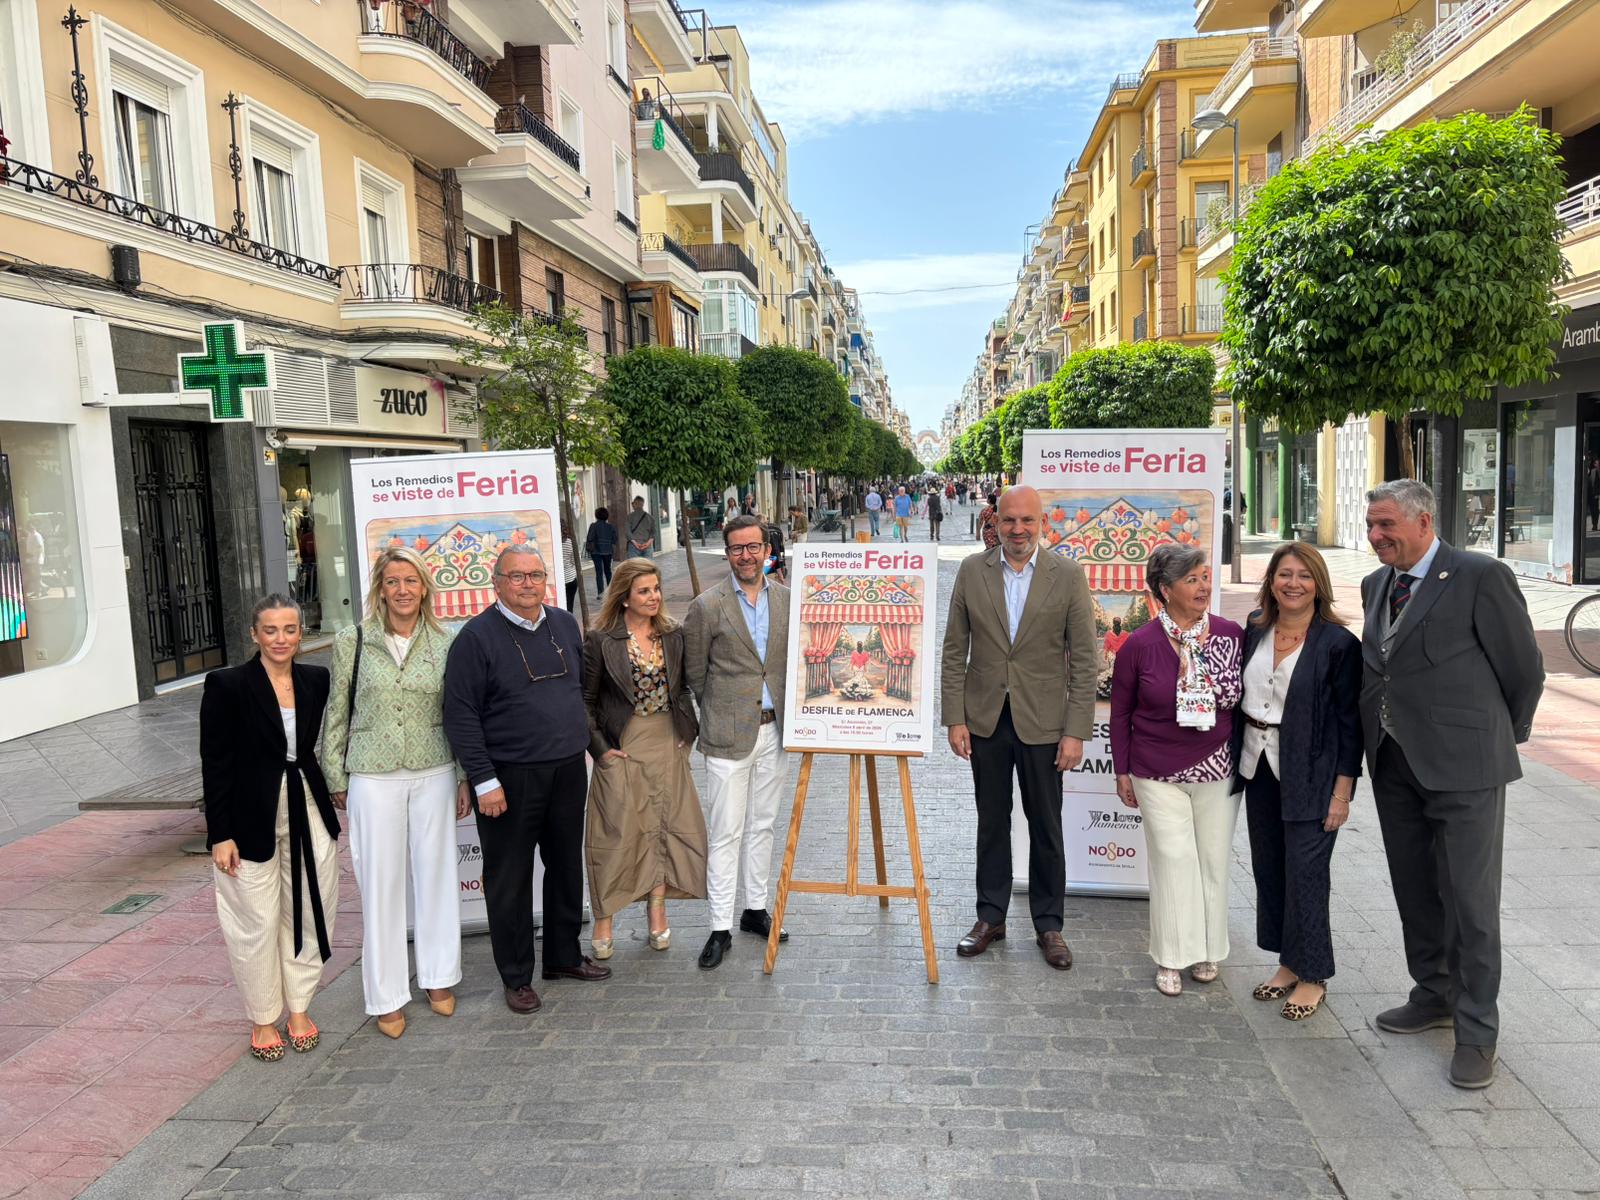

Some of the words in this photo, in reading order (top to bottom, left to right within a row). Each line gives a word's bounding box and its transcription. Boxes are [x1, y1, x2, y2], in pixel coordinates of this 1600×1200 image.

[1562, 321, 1600, 349] Aramb
[1040, 449, 1061, 459] Los
[1064, 448, 1121, 459] Remedios
[1040, 462, 1056, 473] se
[1059, 459, 1100, 473] viste
[1103, 462, 1120, 473] de
[1124, 447, 1206, 474] Feria
[371, 478, 393, 488] Los
[395, 474, 454, 486] Remedios
[372, 493, 389, 503] se
[392, 486, 433, 502] viste
[437, 487, 455, 499] de
[456, 469, 539, 498] Feria
[804, 551, 820, 559] Los
[821, 551, 863, 559] Remedios
[804, 561, 816, 569] se
[818, 559, 847, 569] viste
[849, 561, 862, 569] de
[864, 550, 924, 570] Feria
[801, 705, 843, 715] DESFILE
[857, 707, 915, 717] FLAMENCA
[1092, 723, 1110, 739] ES
[1104, 743, 1112, 754] D
[1088, 810, 1111, 821] We
[1113, 811, 1142, 824] love
[1082, 819, 1139, 831] flamenco
